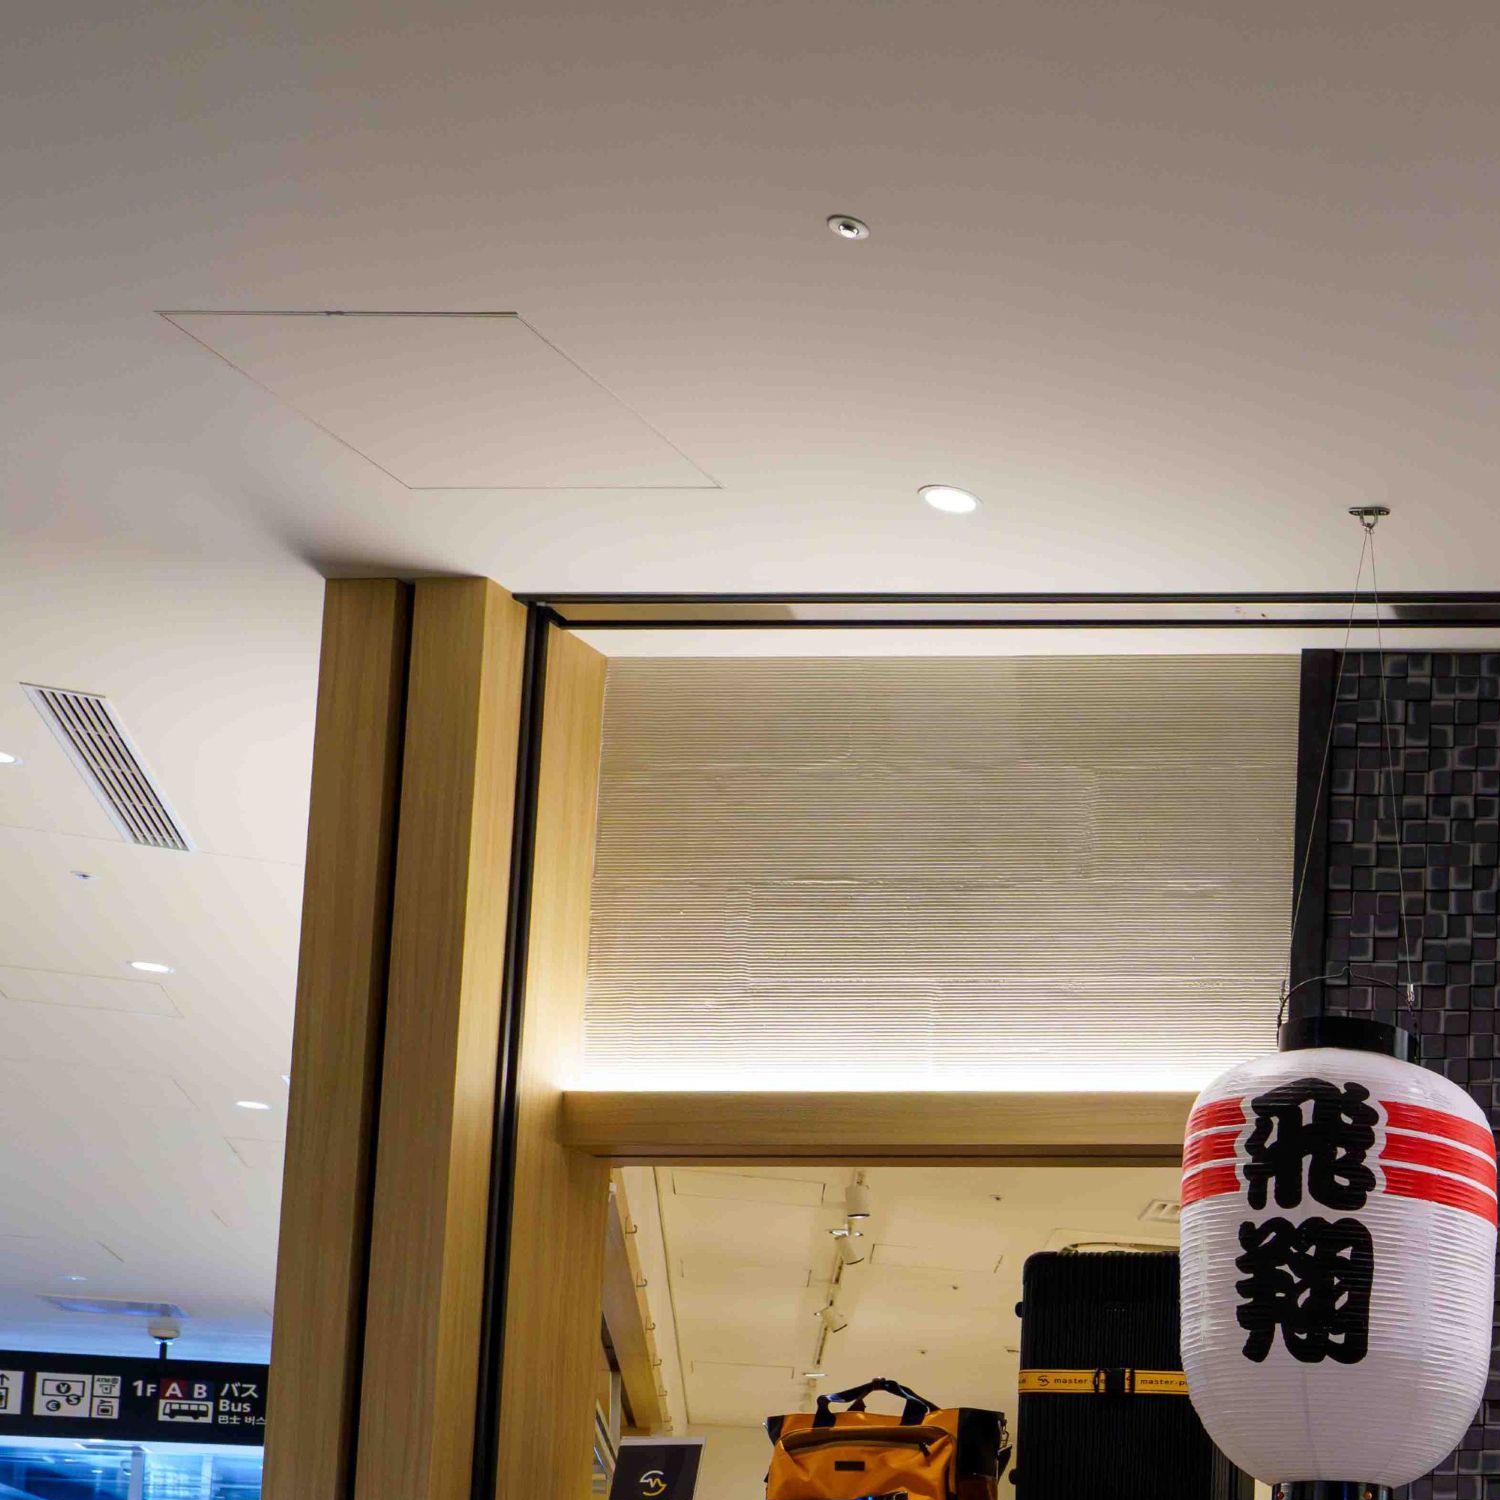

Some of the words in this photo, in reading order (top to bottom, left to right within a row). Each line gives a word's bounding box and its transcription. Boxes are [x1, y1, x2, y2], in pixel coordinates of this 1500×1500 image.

[1236, 1078, 1378, 1364] 飛翔
[133, 1380, 157, 1397] 1F
[165, 1384, 183, 1398] A
[193, 1384, 207, 1399] B
[220, 1382, 259, 1399] バス
[219, 1399, 251, 1413] Bus
[217, 1415, 241, 1425] 巴士
